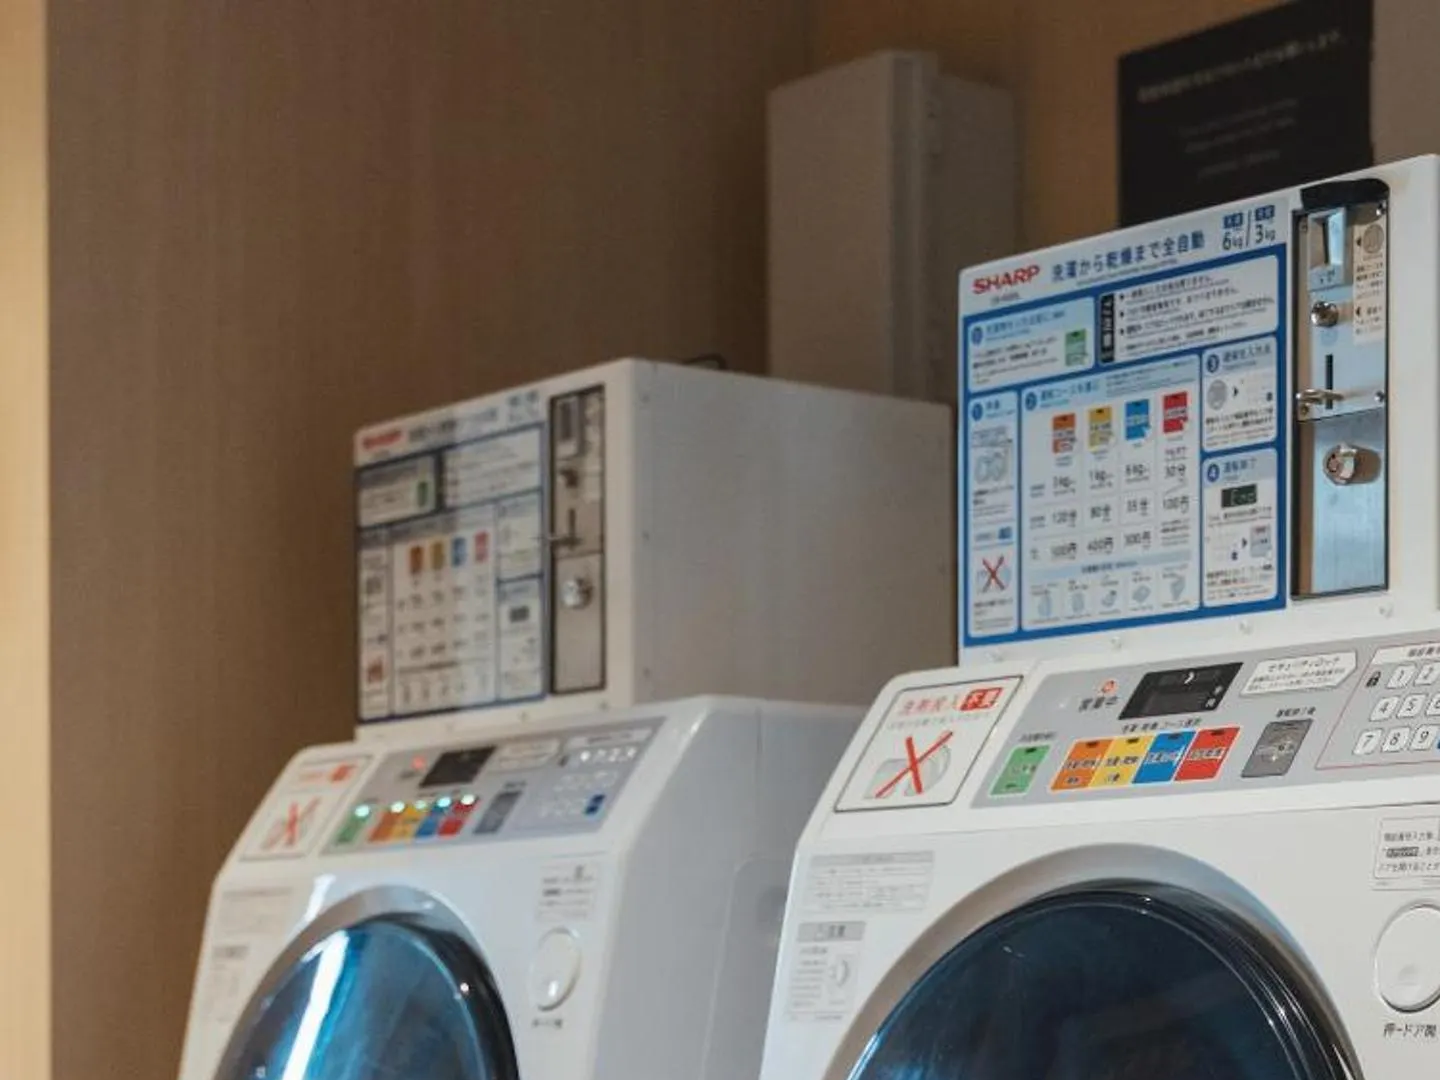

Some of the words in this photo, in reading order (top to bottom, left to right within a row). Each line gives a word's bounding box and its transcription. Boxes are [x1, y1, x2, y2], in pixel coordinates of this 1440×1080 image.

[1051, 229, 1205, 283] 洗濯から乾燥まで全自動
[971, 264, 1041, 295] SHARP
